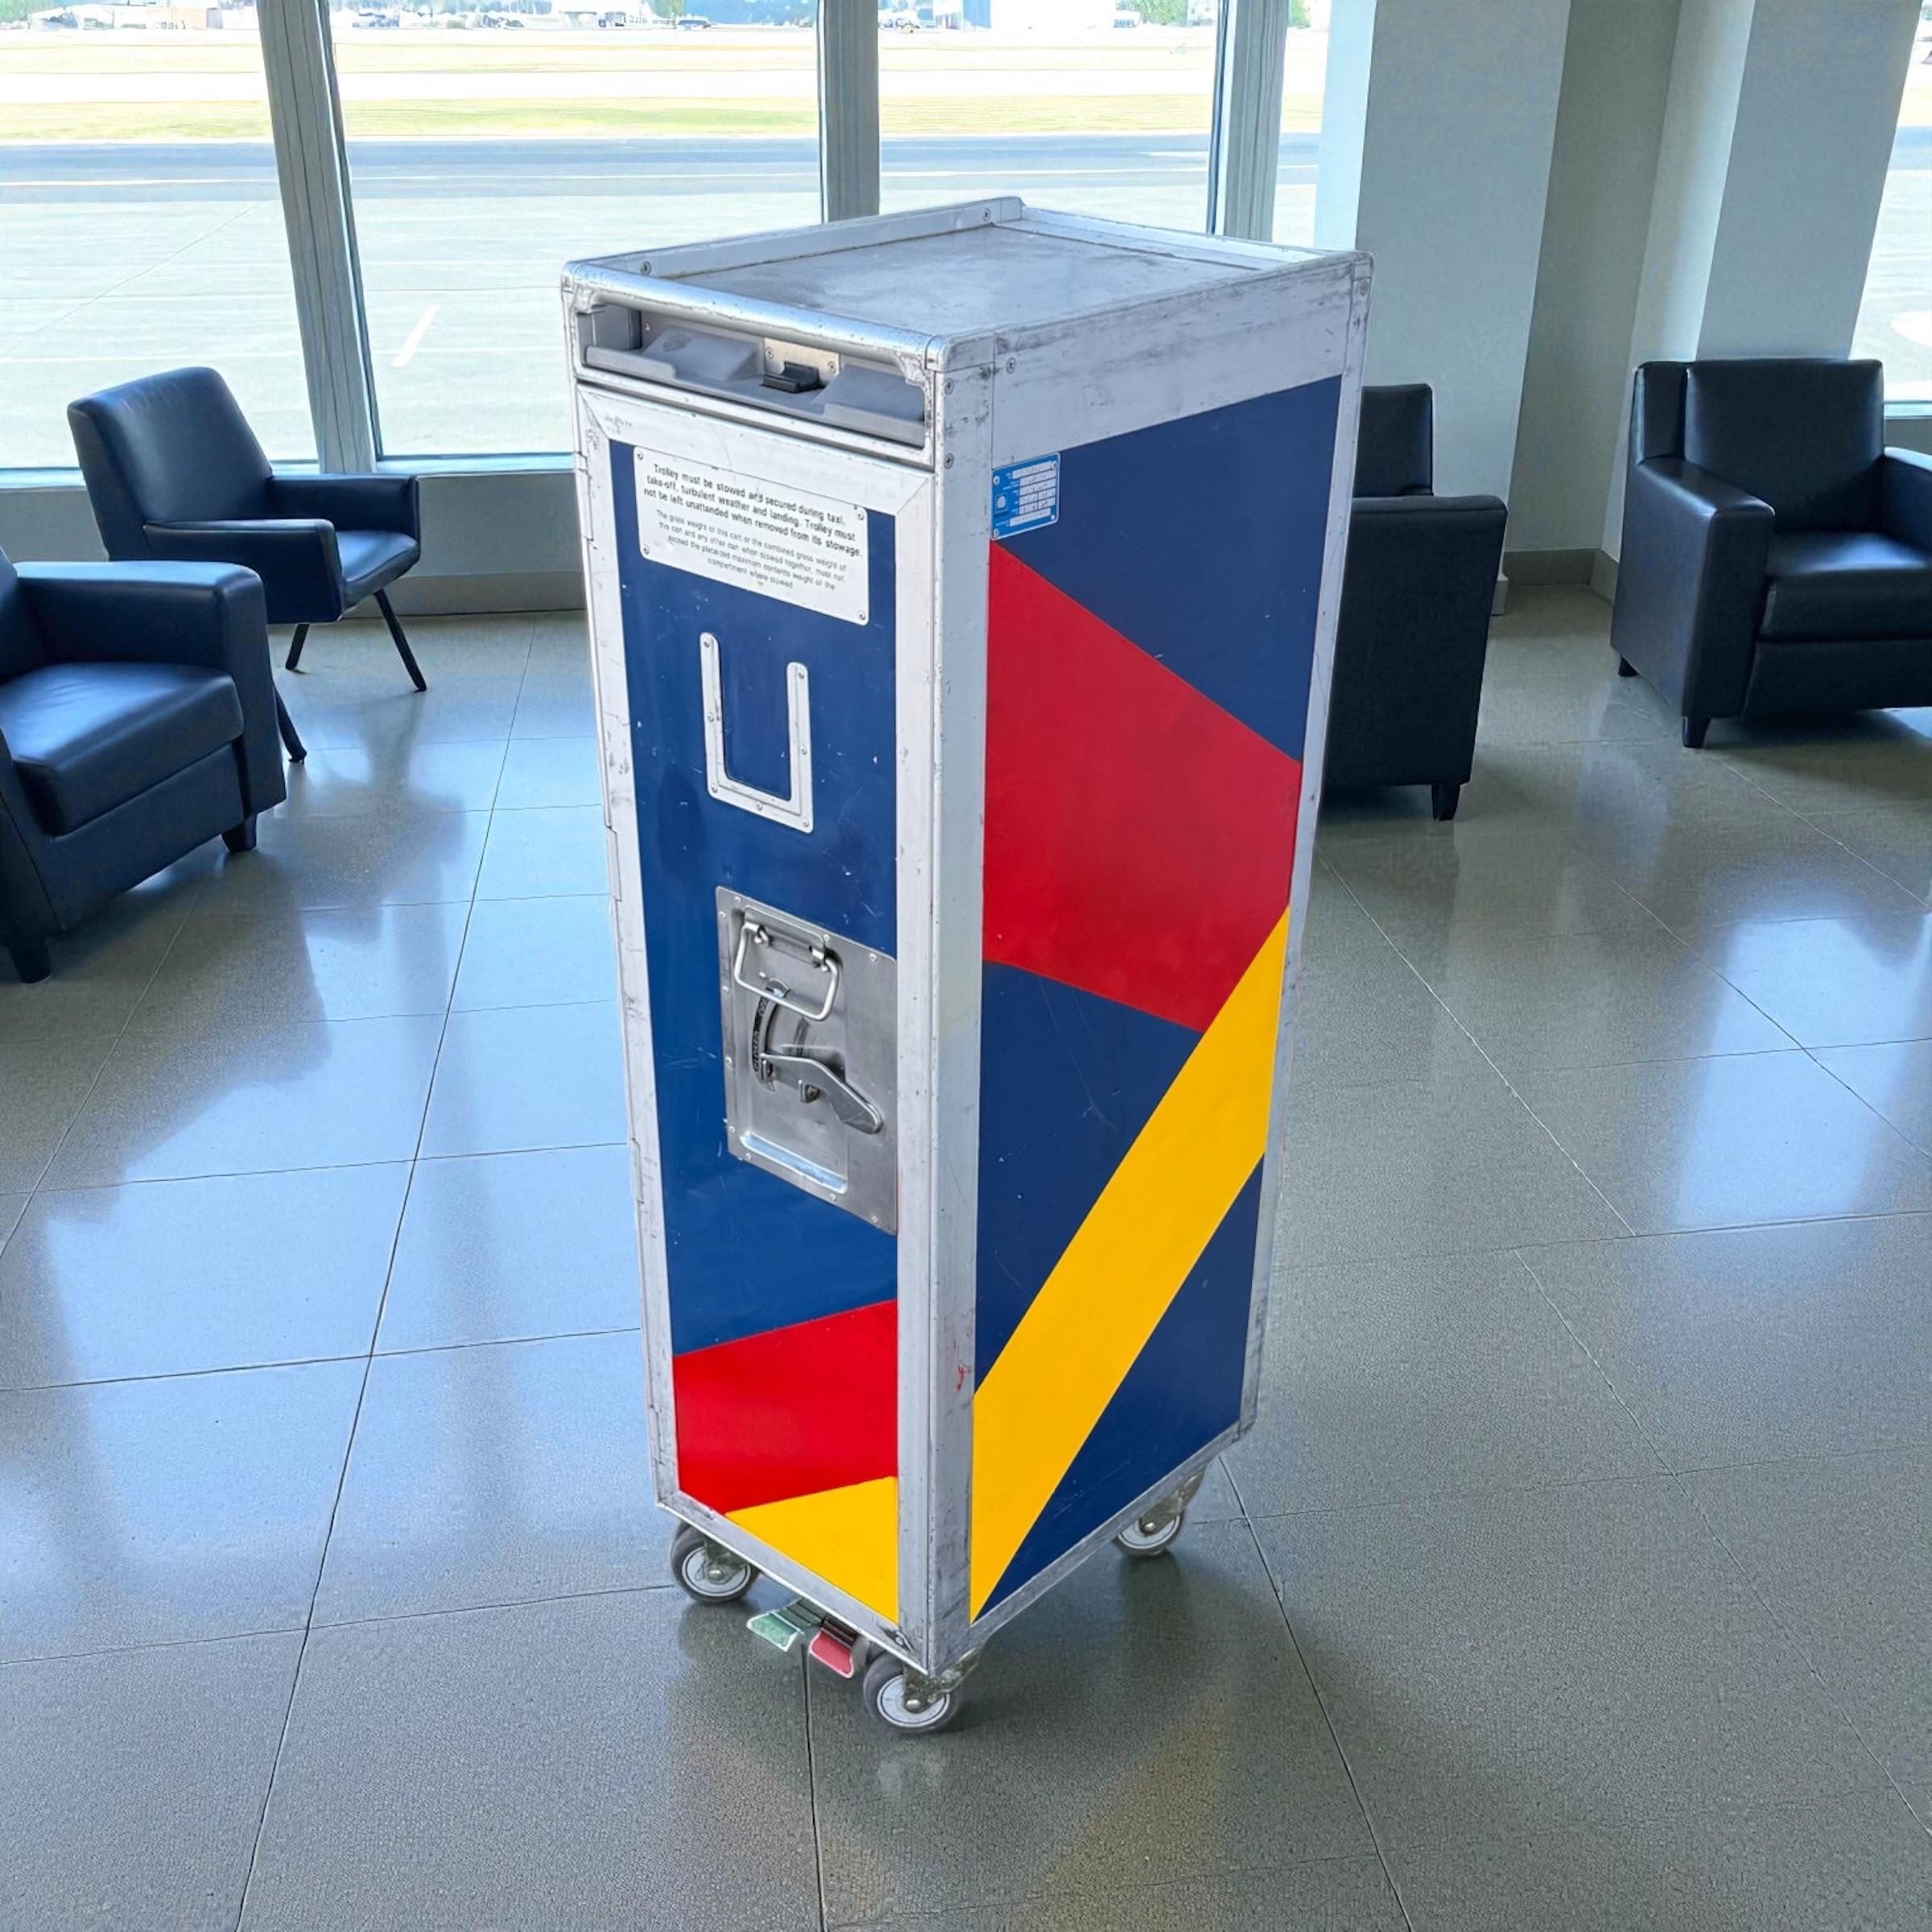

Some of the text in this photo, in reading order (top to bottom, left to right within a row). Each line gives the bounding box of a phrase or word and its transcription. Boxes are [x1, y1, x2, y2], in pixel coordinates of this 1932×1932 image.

[644, 489, 656, 497] not
[658, 491, 667, 501] be
[791, 528, 809, 541] from
[654, 464, 679, 480] Trolley
[682, 474, 700, 485] must
[704, 479, 712, 489] be
[766, 497, 797, 511] secured
[799, 505, 824, 522] during
[718, 497, 749, 511] weather
[753, 506, 767, 517] and
[805, 518, 832, 537] Trolley
[834, 530, 855, 541] must
